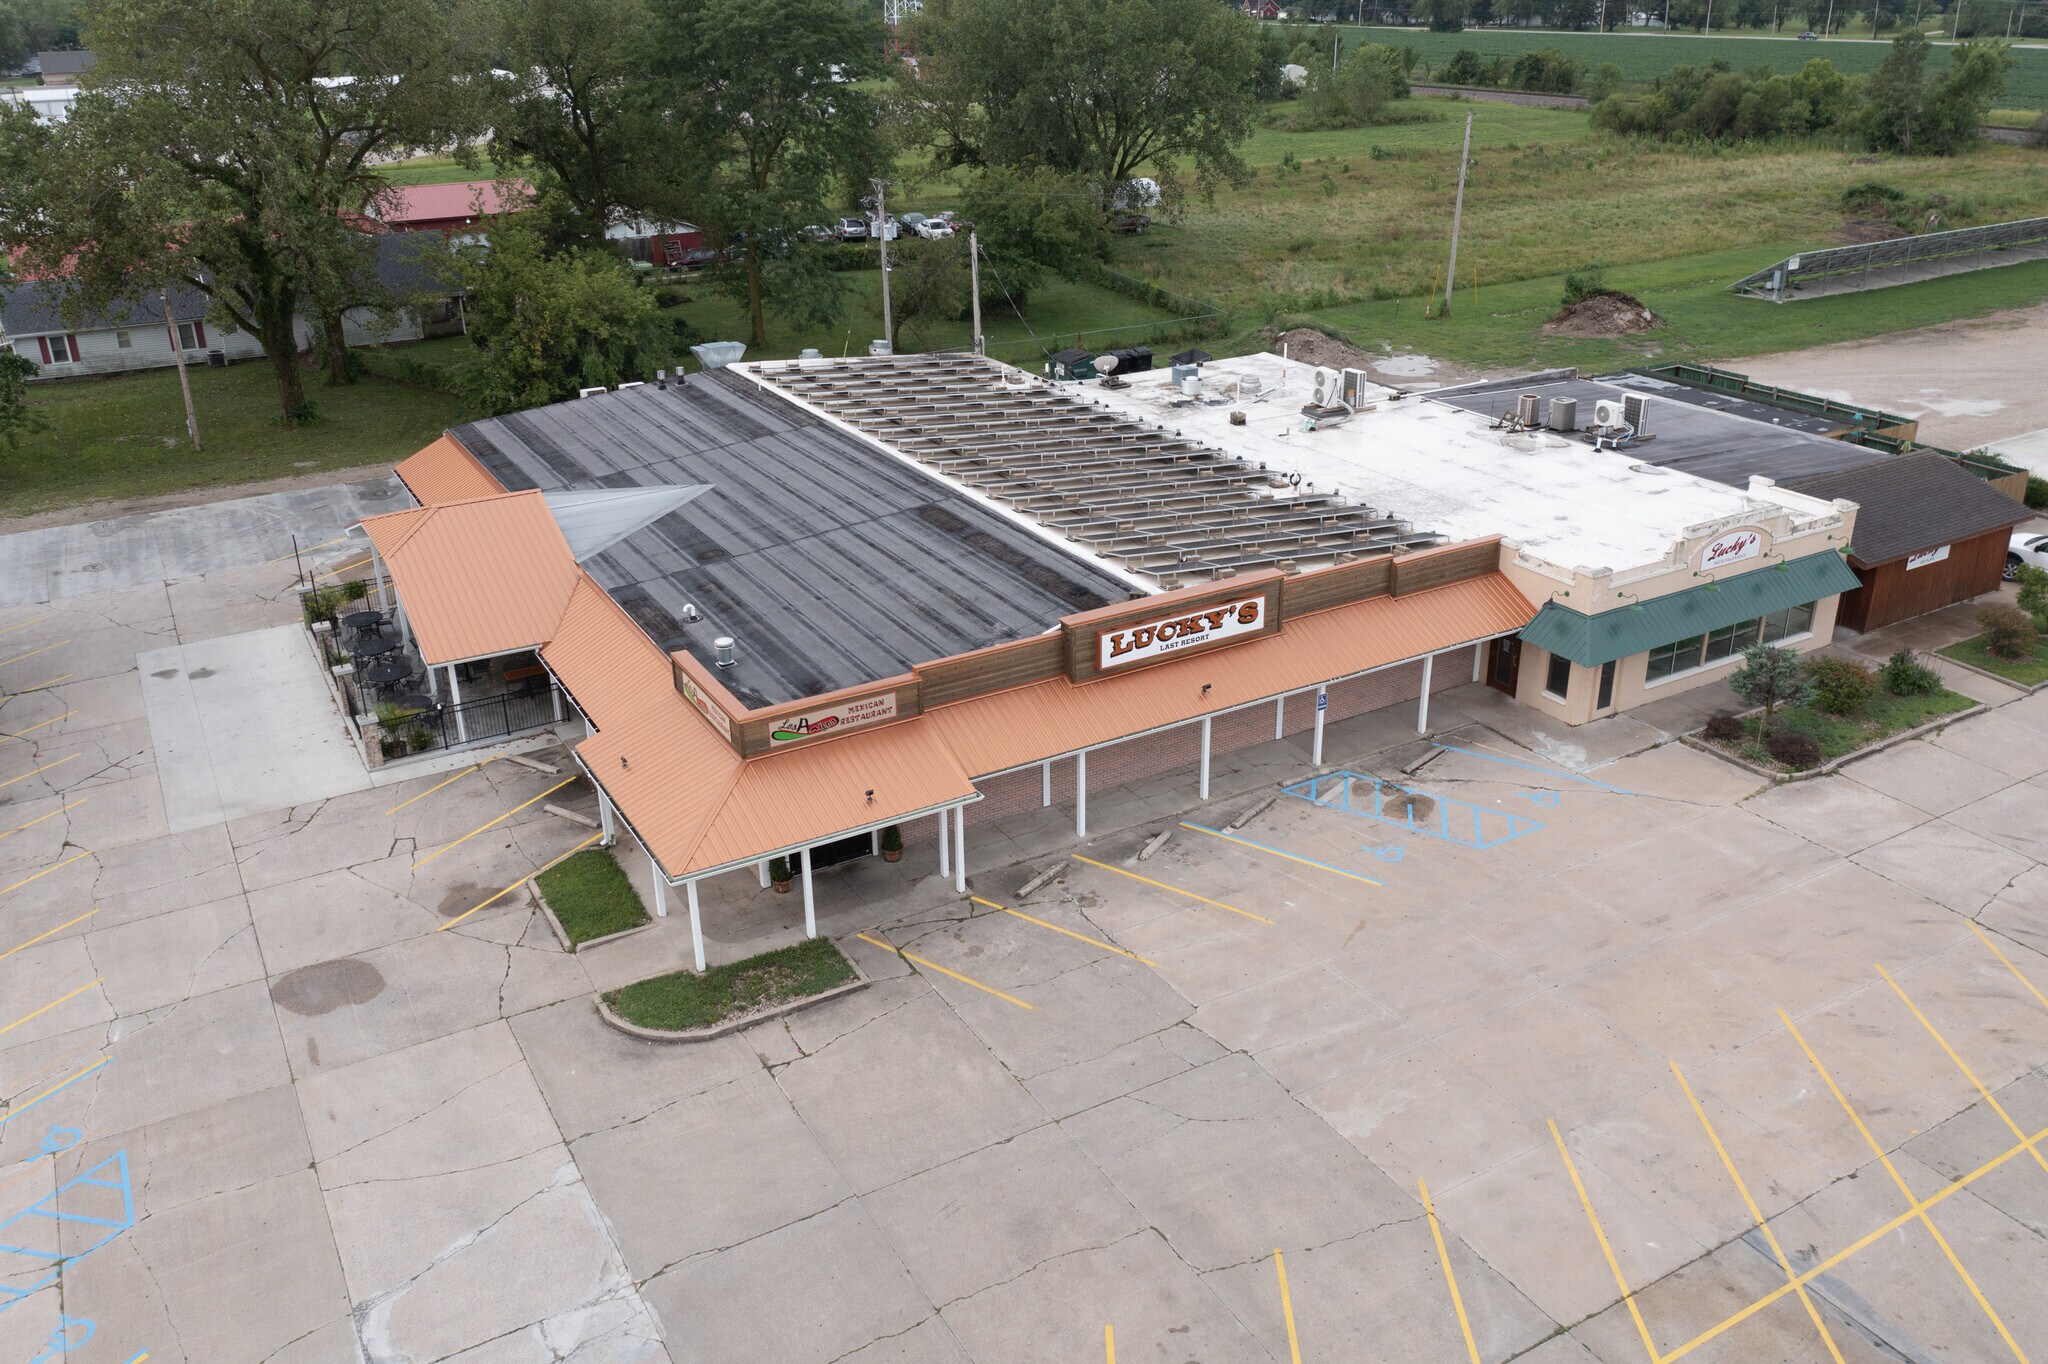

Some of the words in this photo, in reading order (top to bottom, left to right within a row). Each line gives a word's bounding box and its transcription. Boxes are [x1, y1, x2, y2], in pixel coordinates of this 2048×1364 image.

[1707, 533, 1757, 562] Lucky's
[1920, 556, 1936, 565] BAR
[1110, 602, 1259, 658] LUCKY'S
[1160, 641, 1179, 651] LAST
[1180, 634, 1210, 647] RESORT
[848, 699, 885, 714] MEXICAN
[778, 718, 798, 731] Los
[840, 706, 893, 726] RESTAURANT
